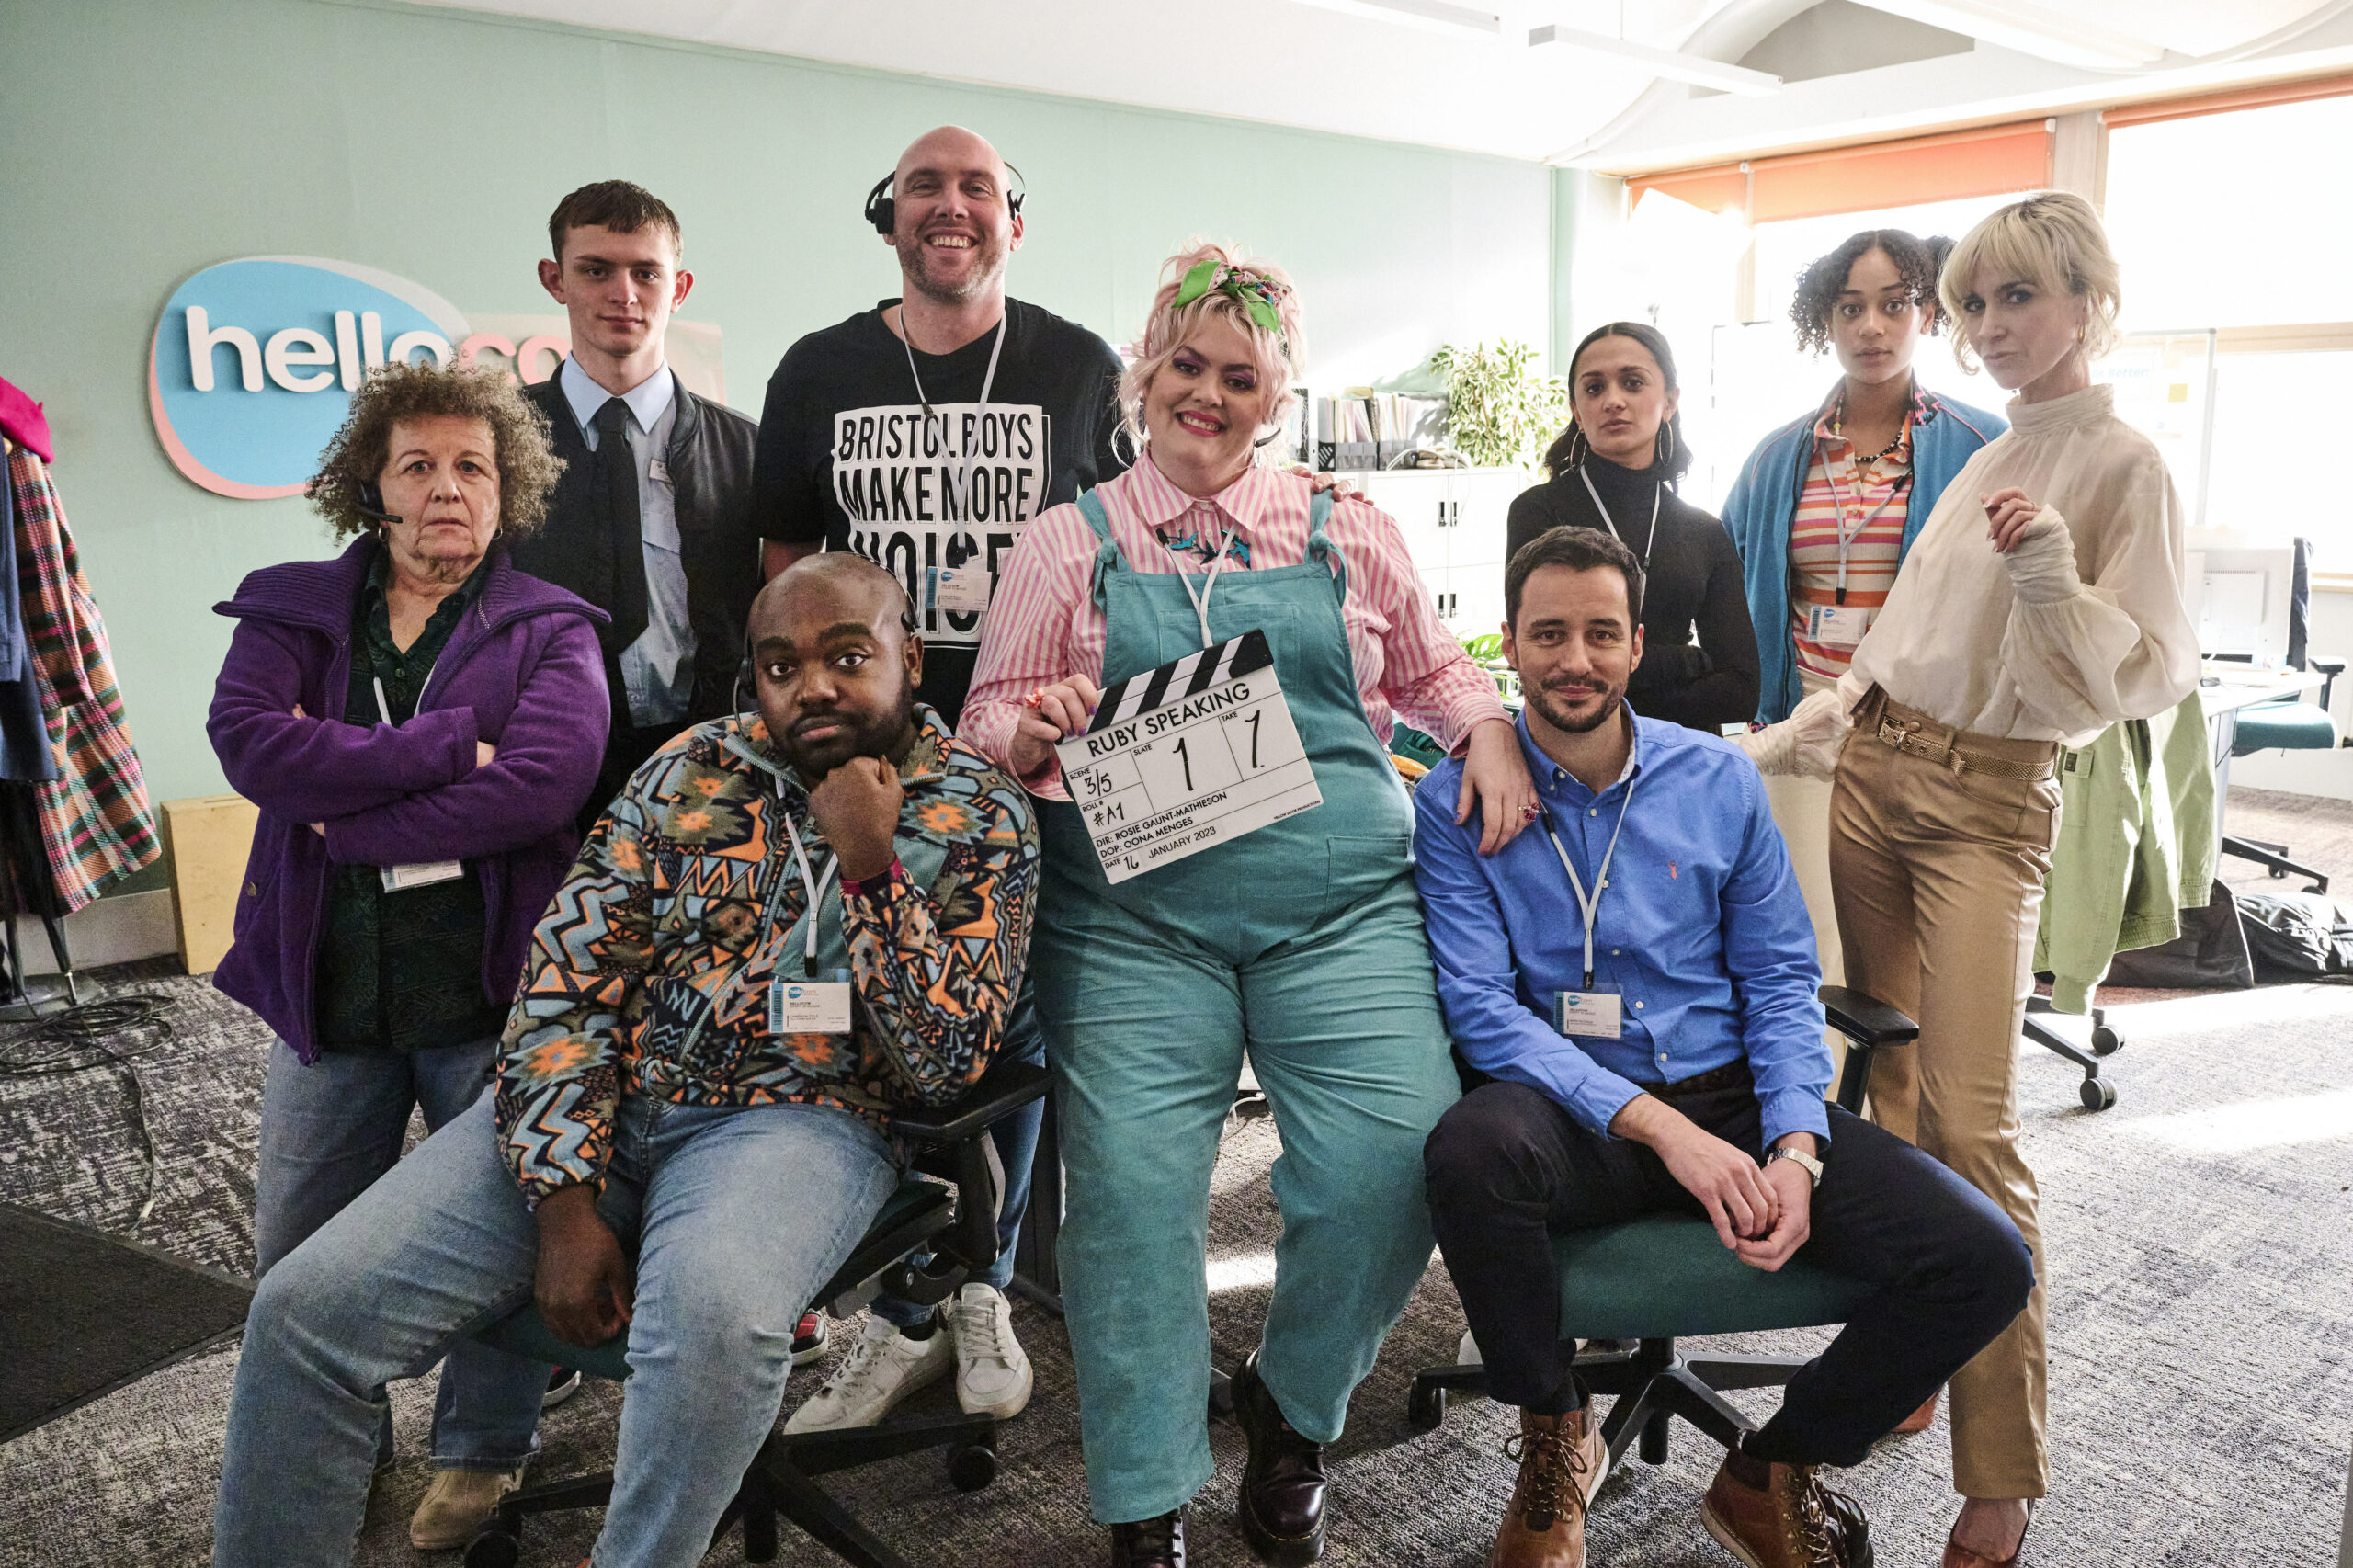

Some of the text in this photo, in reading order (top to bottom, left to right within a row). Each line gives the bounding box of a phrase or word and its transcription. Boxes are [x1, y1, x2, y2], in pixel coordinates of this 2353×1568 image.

[460, 332, 576, 386] co
[838, 413, 1032, 461] BRISTOL BOYS
[839, 466, 1032, 523] MAKE MORE
[1087, 682, 1250, 757] RUBY SPEAKING
[1222, 711, 1238, 722] TAKE
[1133, 744, 1153, 756] SLATE
[1172, 737, 1194, 791] 1
[1069, 767, 1091, 780] SCENE
[1085, 768, 1112, 797] 3/5
[1082, 802, 1098, 812] ROLL
[1096, 791, 1228, 848] DIR: ROSIE GAUNT-MATHIESON
[1099, 816, 1194, 858] DOP: OONA MENGES
[1148, 825, 1217, 859] JANUARY 2023
[1105, 858, 1121, 869] DATE
